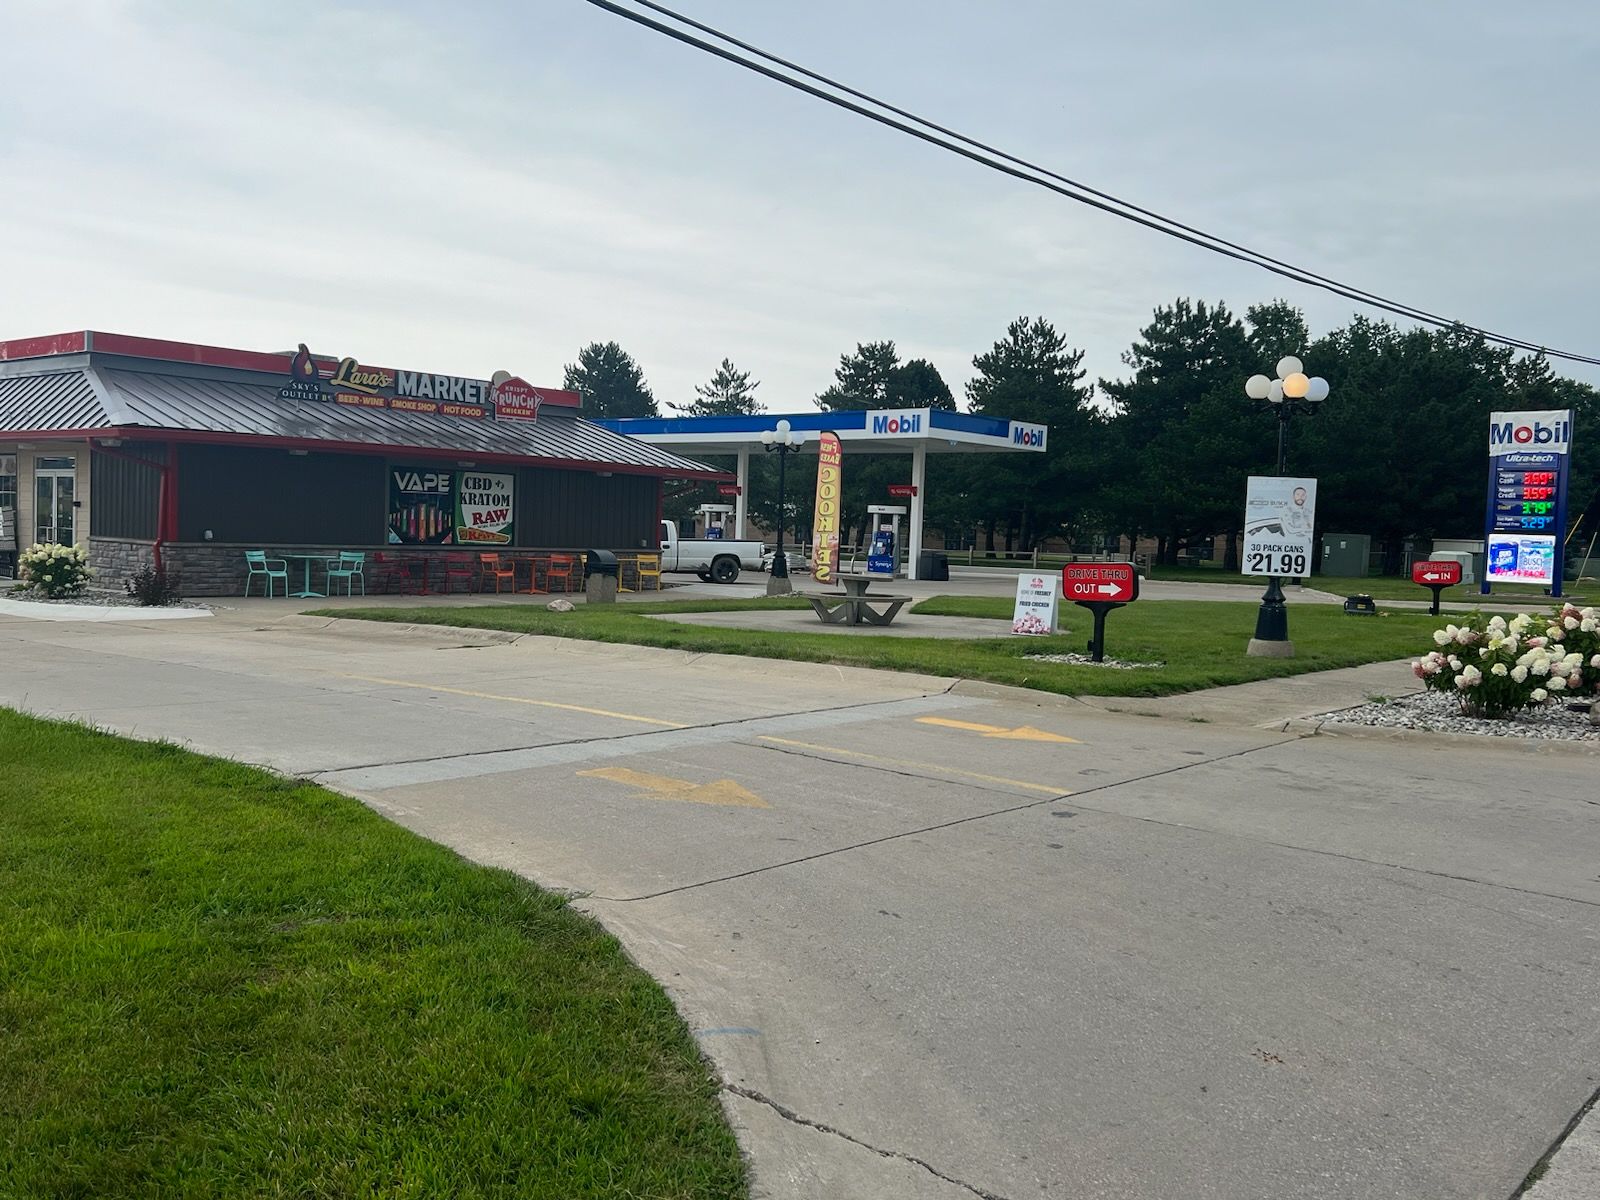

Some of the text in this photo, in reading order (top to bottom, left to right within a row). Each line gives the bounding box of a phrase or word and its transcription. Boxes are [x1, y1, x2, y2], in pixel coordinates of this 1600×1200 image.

[330, 357, 390, 393] Lara's
[292, 382, 319, 392] SKY'S
[398, 371, 488, 403] MARKET
[505, 385, 528, 393] KRISPY
[282, 390, 320, 400] OUTLET
[491, 388, 541, 409] KRUNCHY
[391, 399, 437, 412] SMOKE SHOP
[444, 405, 482, 417] HOT FOOD
[502, 407, 531, 415] CHICKEN
[873, 414, 921, 434] Mobil
[1014, 427, 1043, 447] Mobil
[1491, 421, 1568, 445] Mobil
[393, 471, 451, 492] VAPE
[464, 476, 492, 490] CBD
[460, 491, 510, 506] KRATOM
[472, 509, 510, 525] RAW
[1250, 543, 1304, 553] 30 PACK CANS
[1247, 553, 1306, 574] $21.99
[1068, 569, 1128, 580] DRIVE THRU
[1440, 572, 1451, 580] IN
[1074, 583, 1096, 594] OUT
